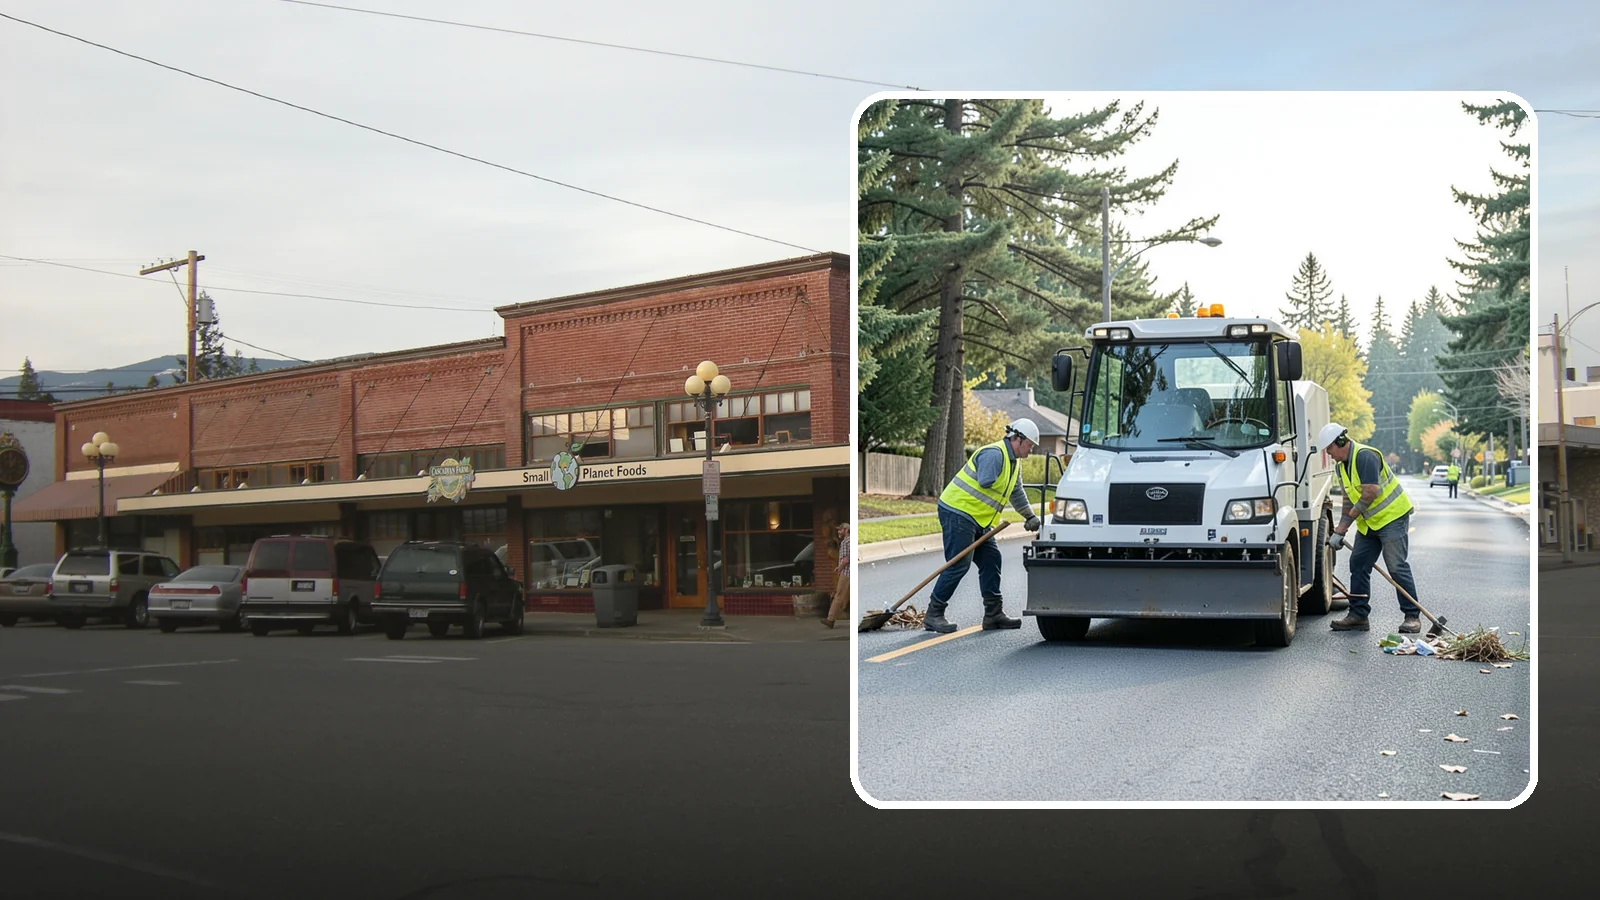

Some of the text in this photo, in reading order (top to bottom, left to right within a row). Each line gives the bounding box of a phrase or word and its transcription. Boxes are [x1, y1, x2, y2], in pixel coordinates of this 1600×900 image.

[523, 464, 647, 483] Small Planet Foods
